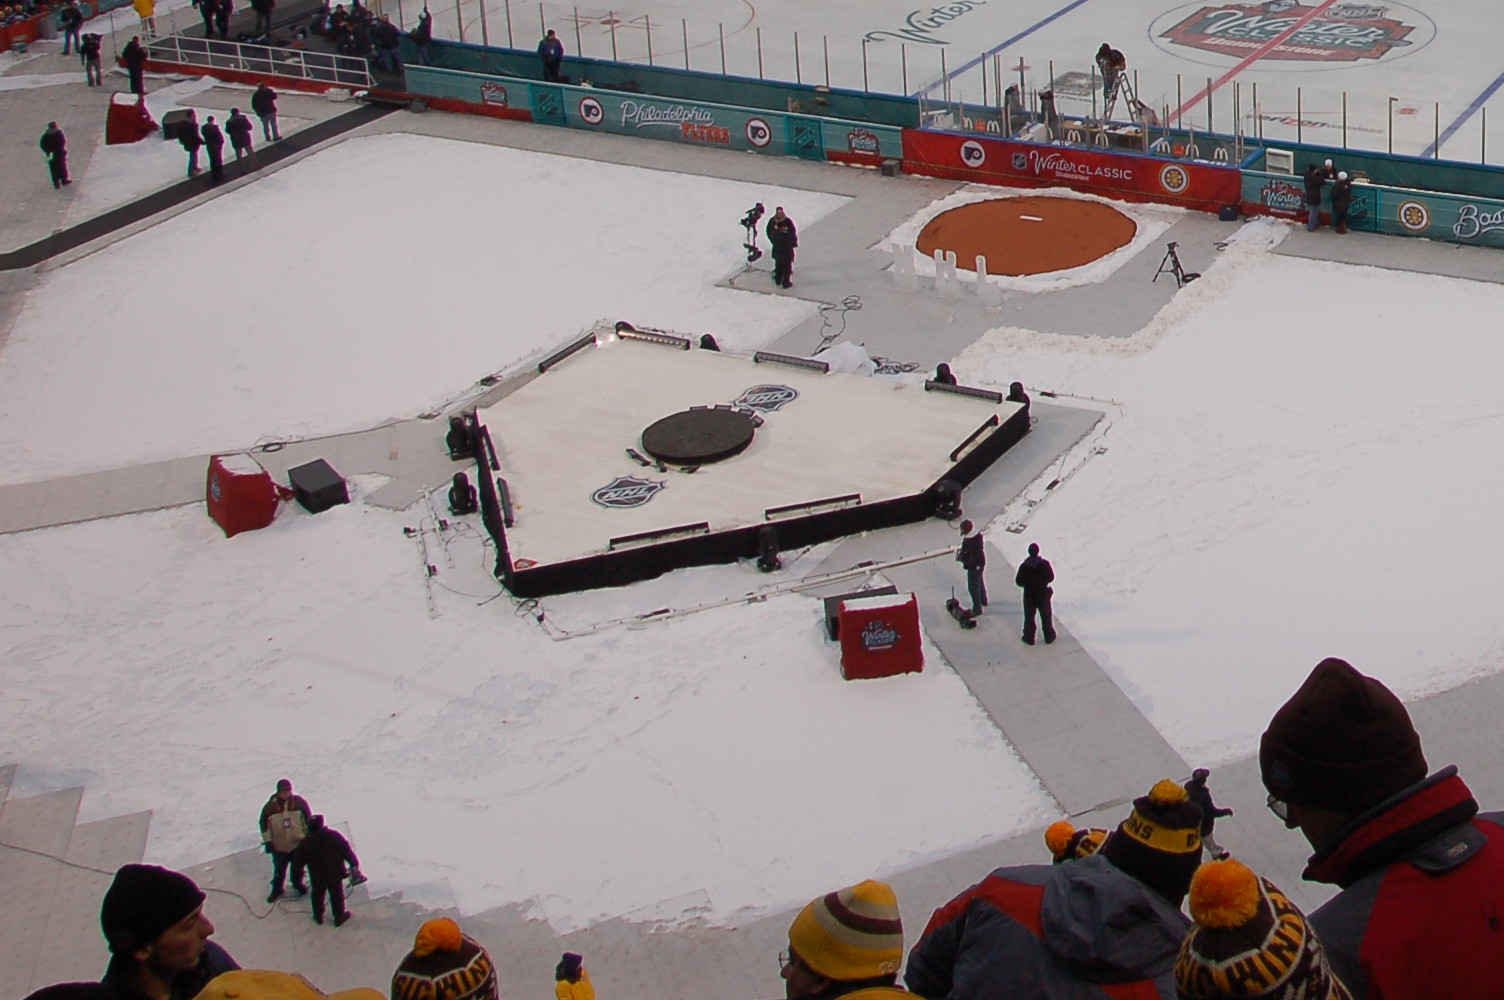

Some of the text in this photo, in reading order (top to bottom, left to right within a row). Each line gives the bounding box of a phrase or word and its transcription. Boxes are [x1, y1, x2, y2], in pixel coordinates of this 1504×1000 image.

[865, 0, 986, 45] Winter
[620, 100, 716, 128] Philadelphia
[680, 121, 730, 145] FLYERS
[1029, 150, 1078, 176] Winter
[1077, 163, 1132, 180] CLASSIC
[1263, 189, 1302, 207] Winter
[602, 483, 660, 499] NHL
